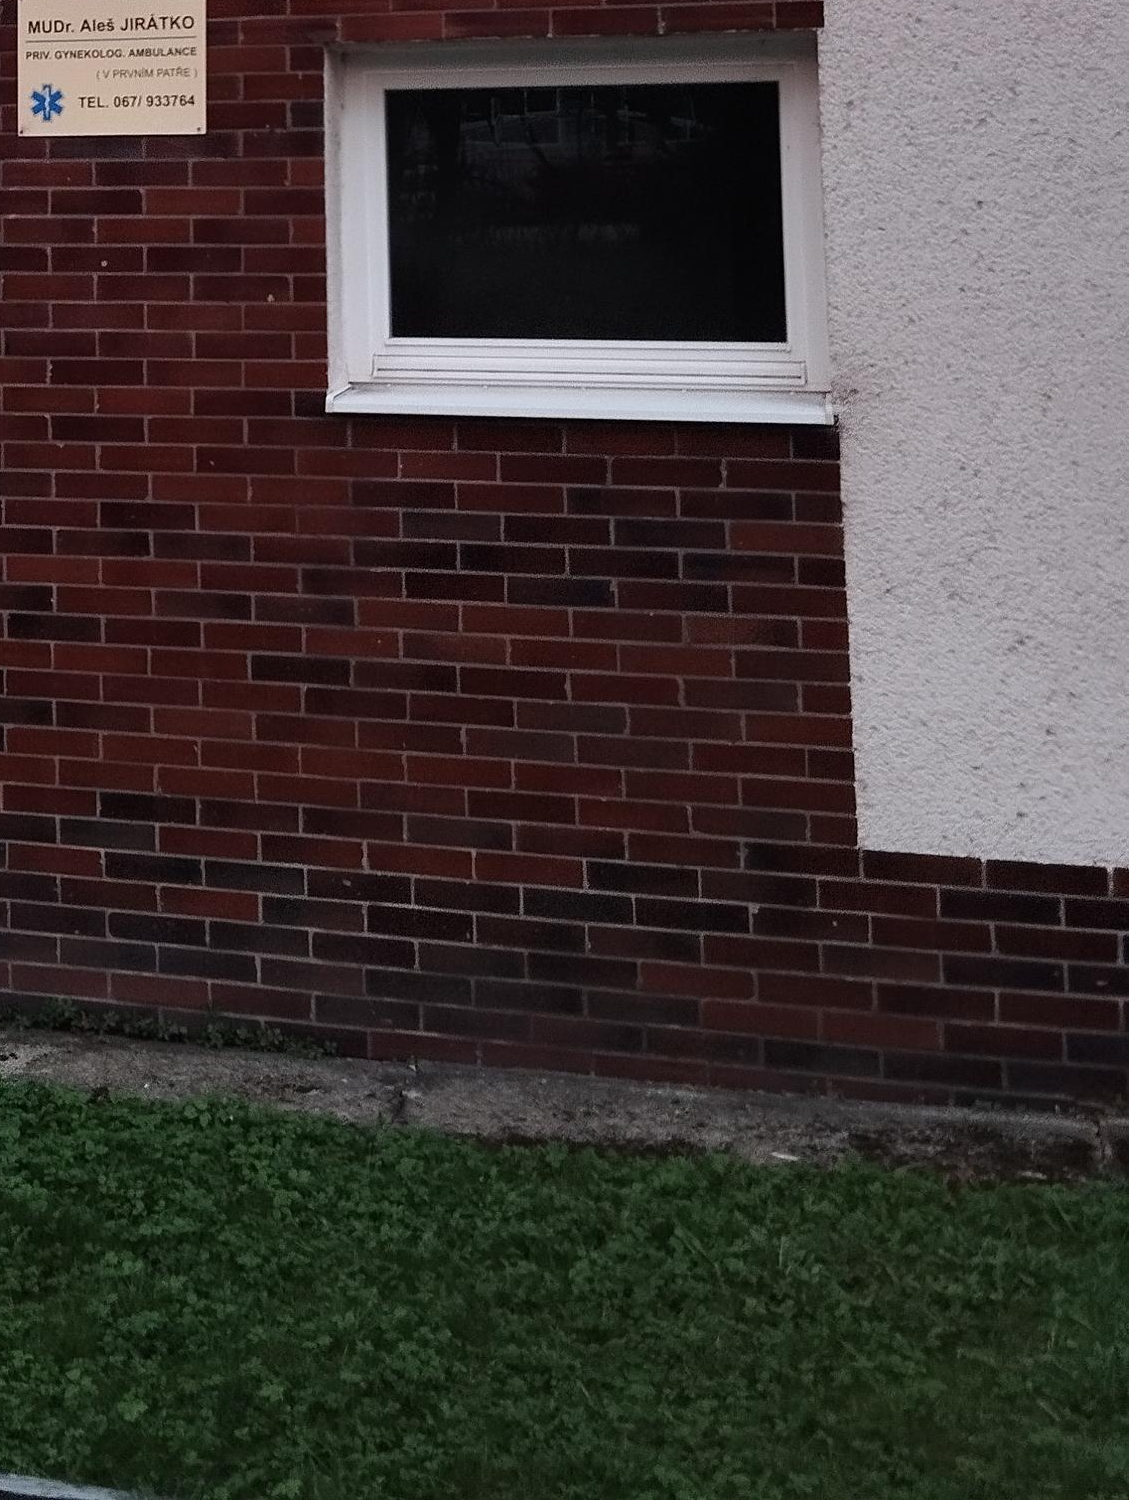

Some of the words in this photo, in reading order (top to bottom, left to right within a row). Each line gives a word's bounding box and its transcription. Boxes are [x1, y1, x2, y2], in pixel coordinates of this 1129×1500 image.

[28, 20, 74, 34] MUDr.
[80, 18, 115, 32] Aleš
[120, 13, 195, 31] JIRÁTKO
[26, 50, 52, 60] PRIV.
[55, 48, 125, 59] GYNEKOLOG.
[128, 47, 197, 57] AMBULANCE
[113, 67, 153, 79] PRVNÍM
[79, 96, 109, 108] TEL.
[146, 94, 195, 107] 933764
